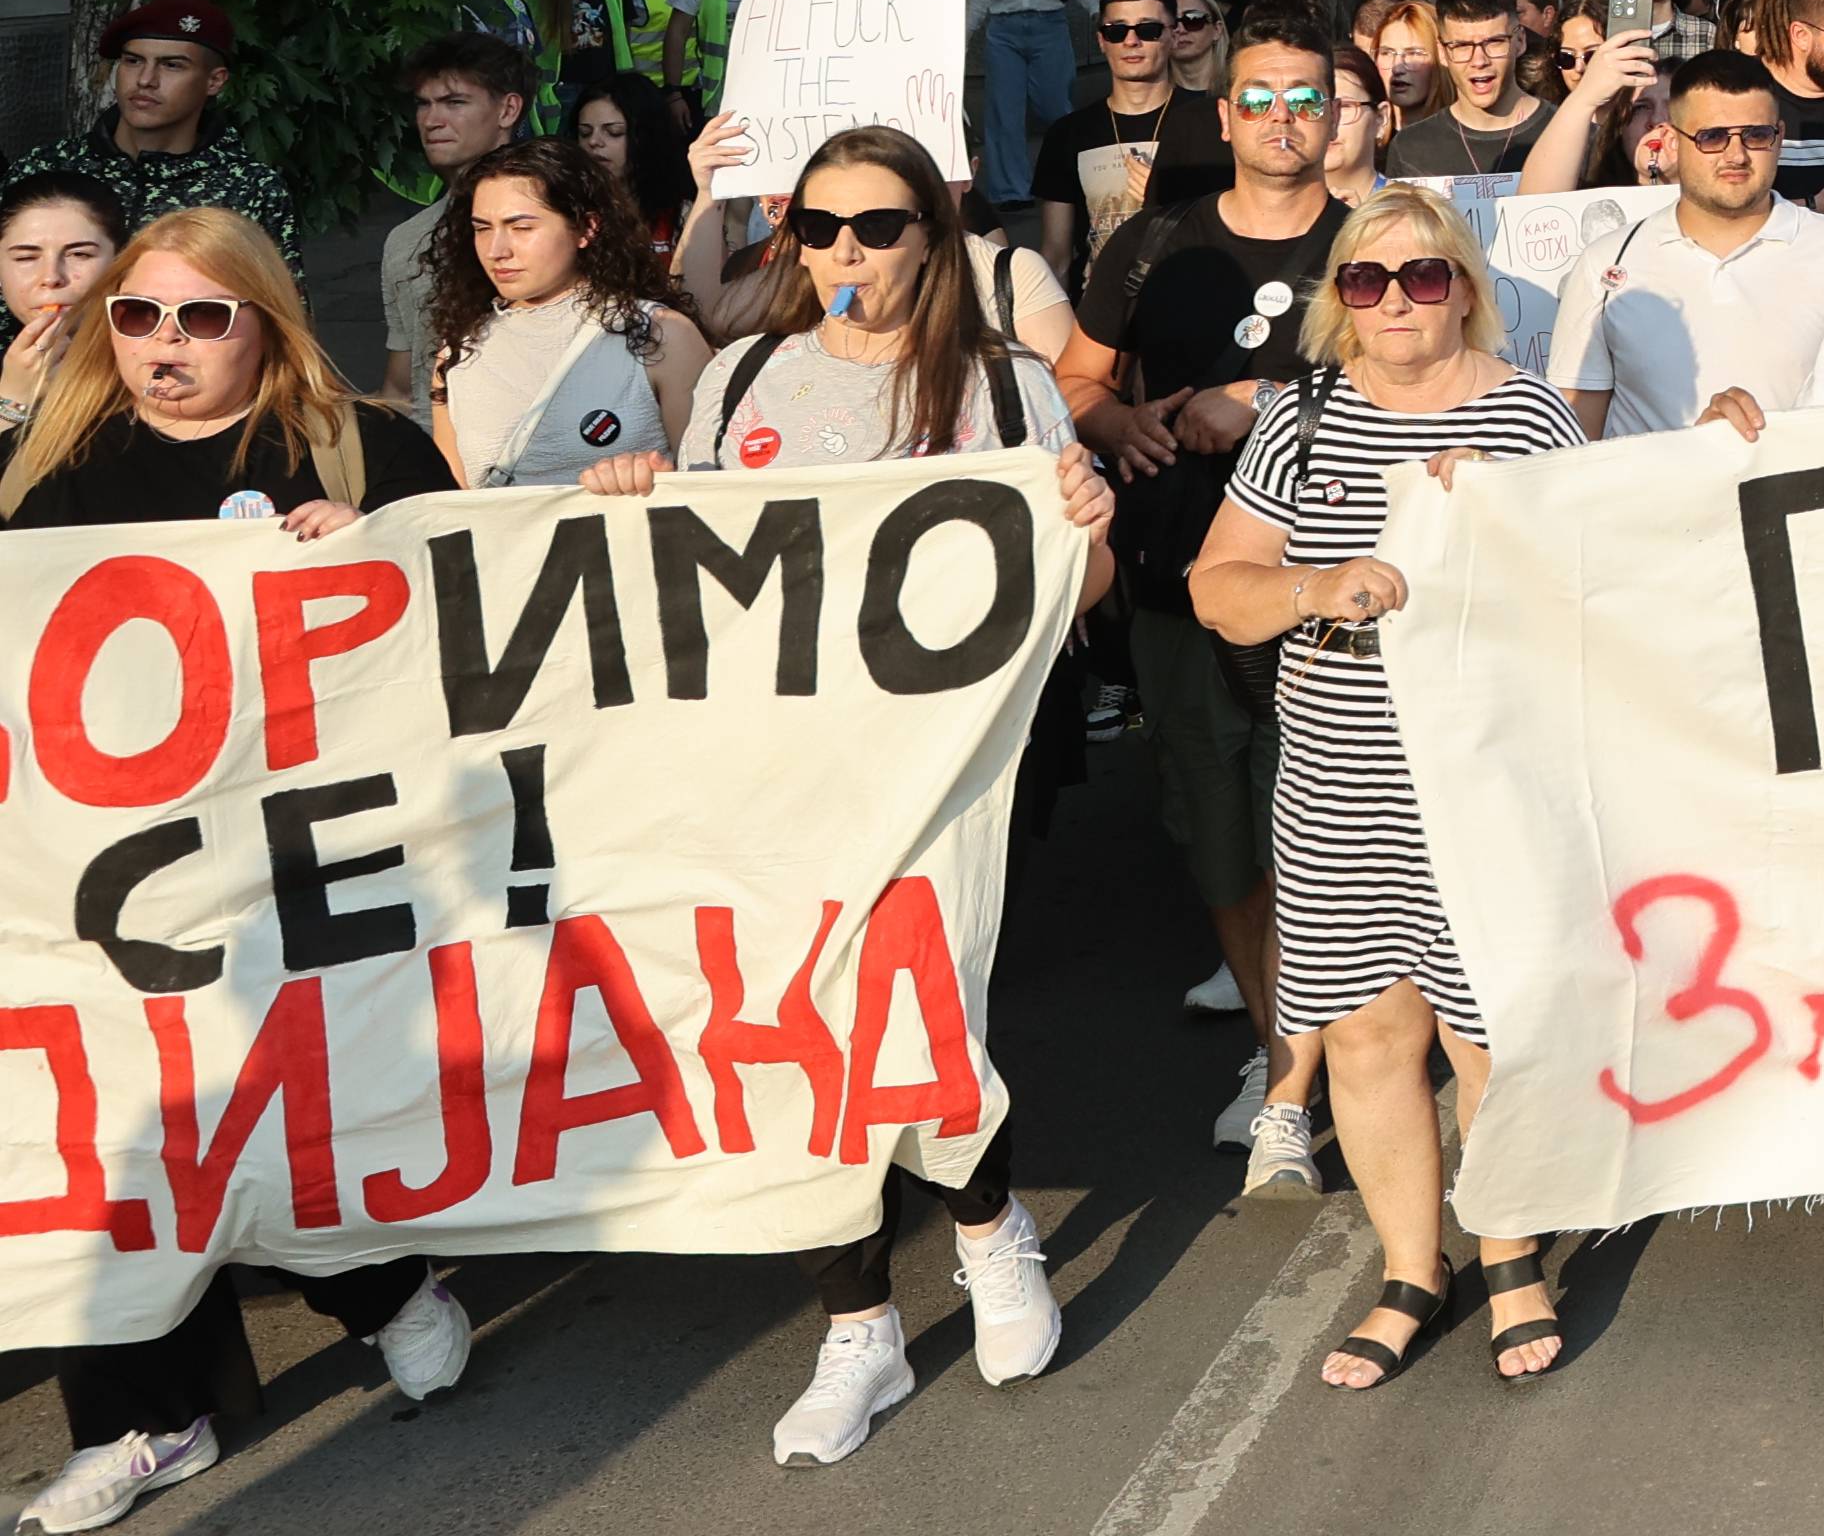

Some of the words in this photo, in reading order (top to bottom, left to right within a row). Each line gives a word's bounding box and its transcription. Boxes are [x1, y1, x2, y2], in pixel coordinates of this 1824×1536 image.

[773, 55, 857, 109] THE
[1524, 219, 1560, 236] КАКО
[0, 479, 1035, 808] ОРИМО
[74, 744, 557, 994] СЕ!
